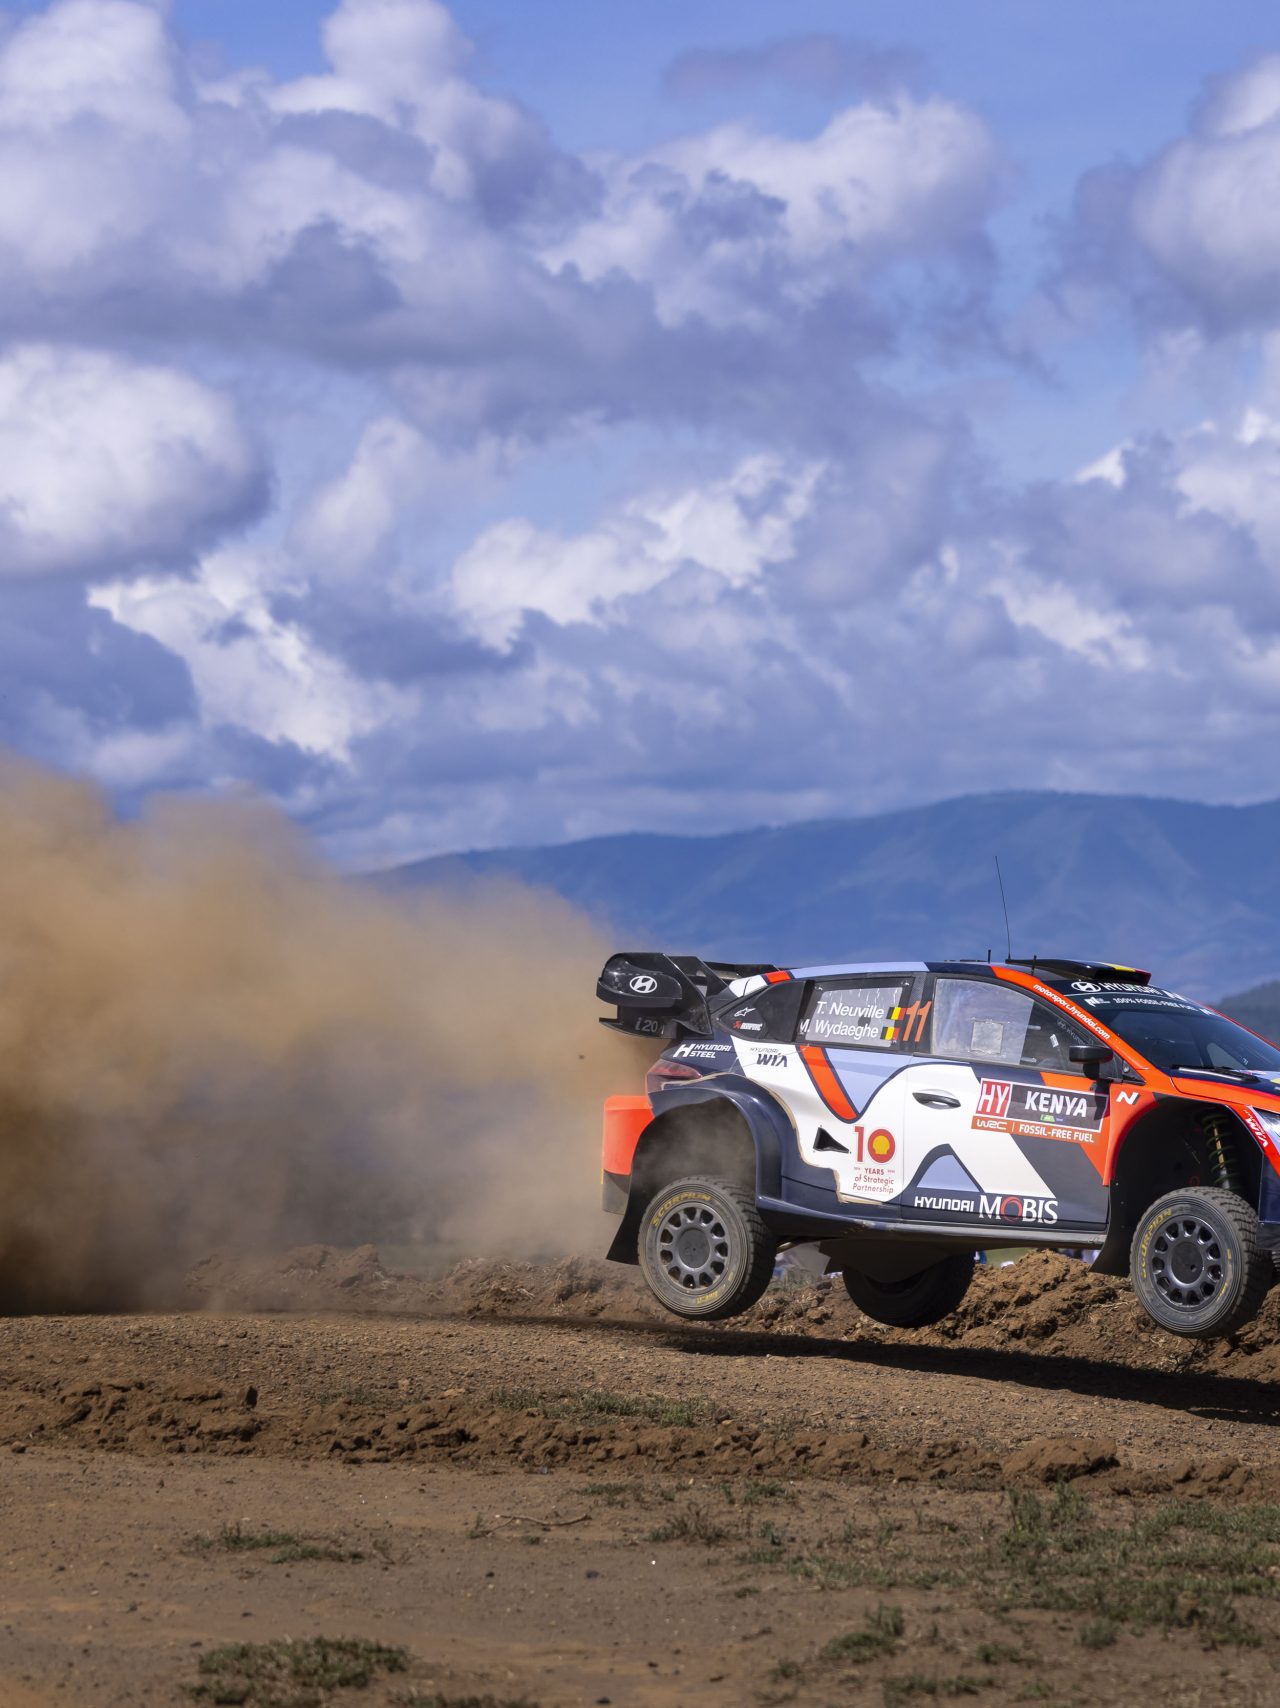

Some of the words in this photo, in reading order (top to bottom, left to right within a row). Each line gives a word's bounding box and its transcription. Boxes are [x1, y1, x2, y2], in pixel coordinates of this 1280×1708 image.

[816, 1001, 827, 1014] T.
[829, 1002, 885, 1018] Neuville
[1033, 984, 1111, 1040] motorsport.hyundai.com
[635, 1017, 658, 1033] i20
[799, 1018, 811, 1033] M.
[815, 1020, 879, 1041] Wydaeghe
[903, 1000, 932, 1043] 11
[689, 1050, 716, 1059] STEEL
[693, 1043, 732, 1052] HYUNDAI
[756, 1053, 788, 1067] WIA
[977, 1083, 1010, 1114] HY
[1025, 1091, 1088, 1118] KENYA
[976, 1119, 1008, 1131] WRC
[1018, 1123, 1072, 1140] FOSSIL-FREE
[1073, 1132, 1095, 1143] FUEL
[864, 1167, 885, 1176] YEARS
[852, 1182, 894, 1194] Partnership
[854, 1174, 862, 1182] of
[863, 1175, 895, 1186] Strategic
[914, 1196, 975, 1213] HYUNDAI
[978, 1195, 1059, 1224] MOBIS
